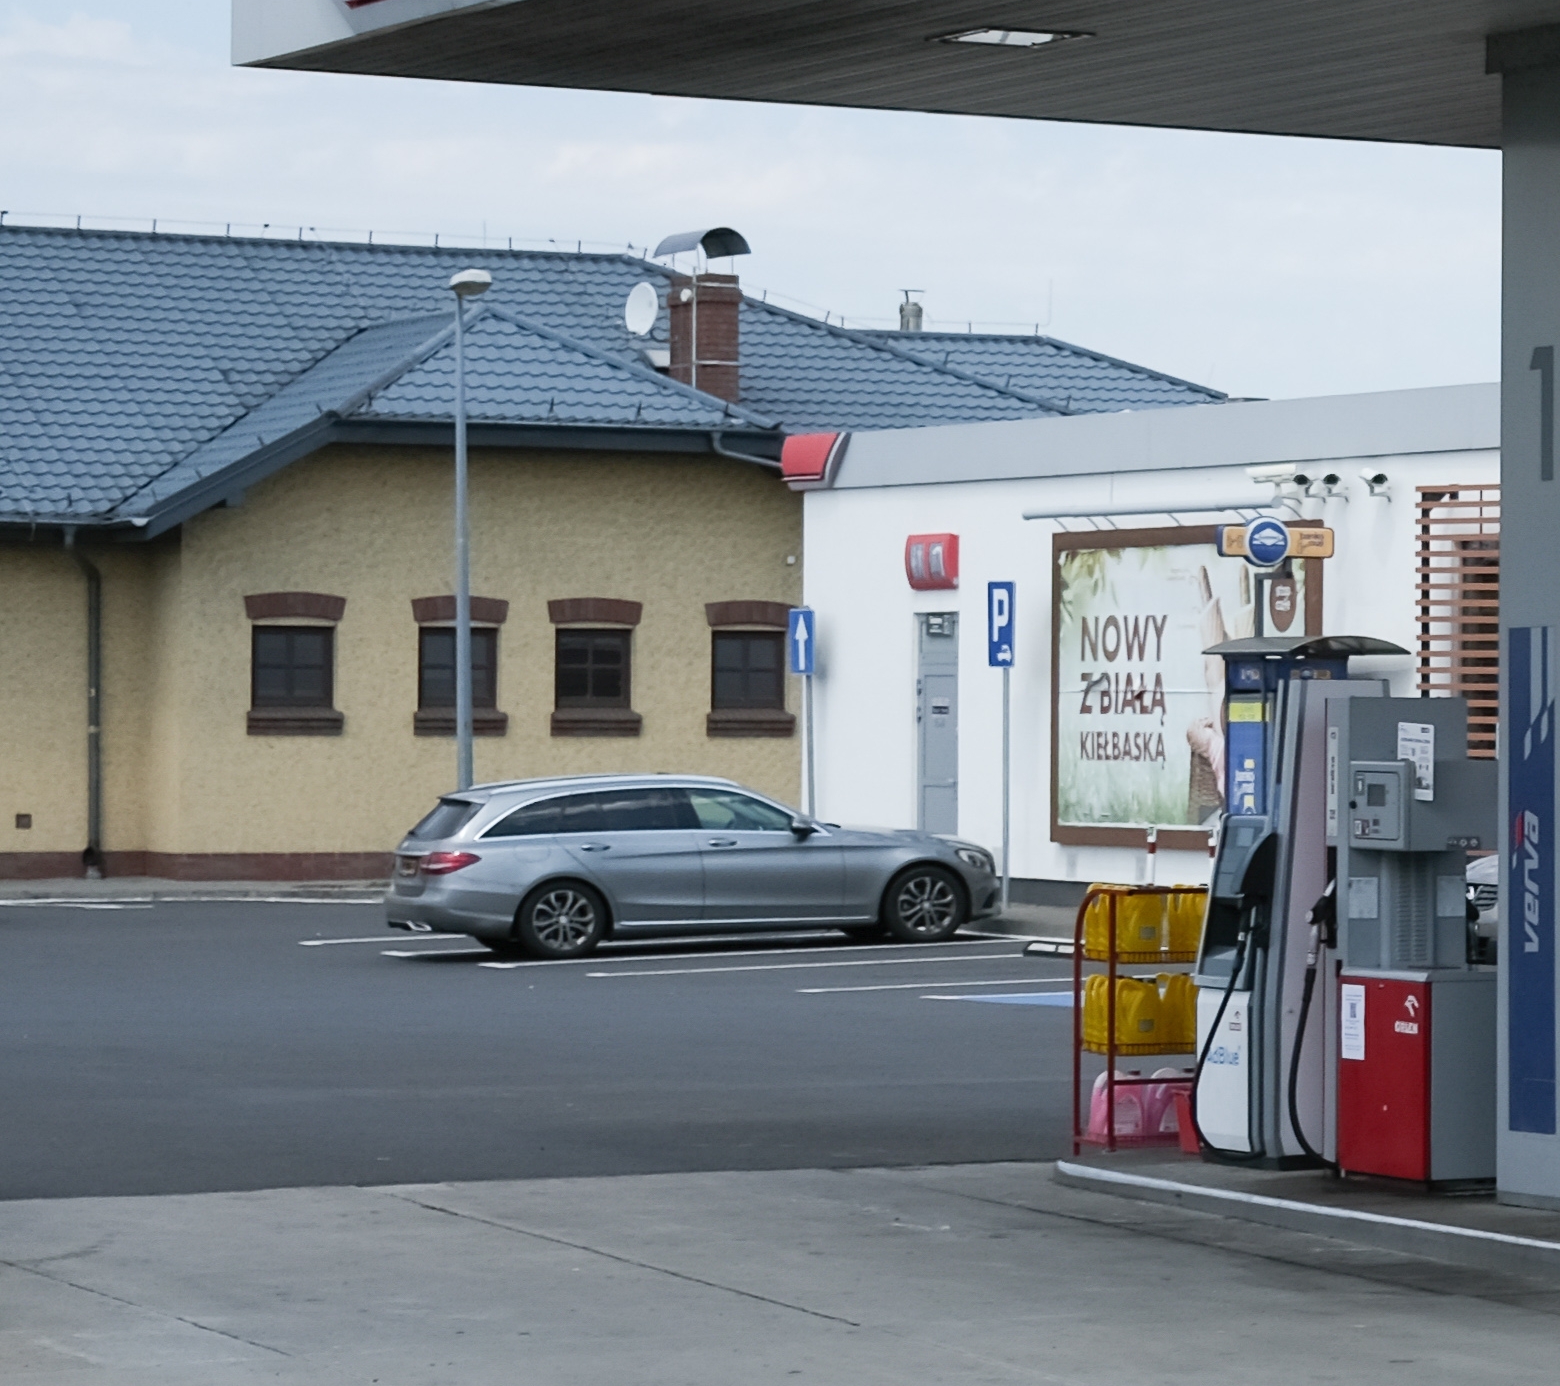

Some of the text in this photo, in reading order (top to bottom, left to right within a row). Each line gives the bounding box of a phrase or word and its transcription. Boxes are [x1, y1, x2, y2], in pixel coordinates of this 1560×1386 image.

[1529, 346, 1555, 482] 1
[992, 588, 1010, 644] P
[1080, 614, 1168, 663] NOWY
[1079, 672, 1167, 727] Z BIAŁĄ
[1079, 731, 1166, 770] KIEŁBASKĄ
[1523, 810, 1541, 954] verva
